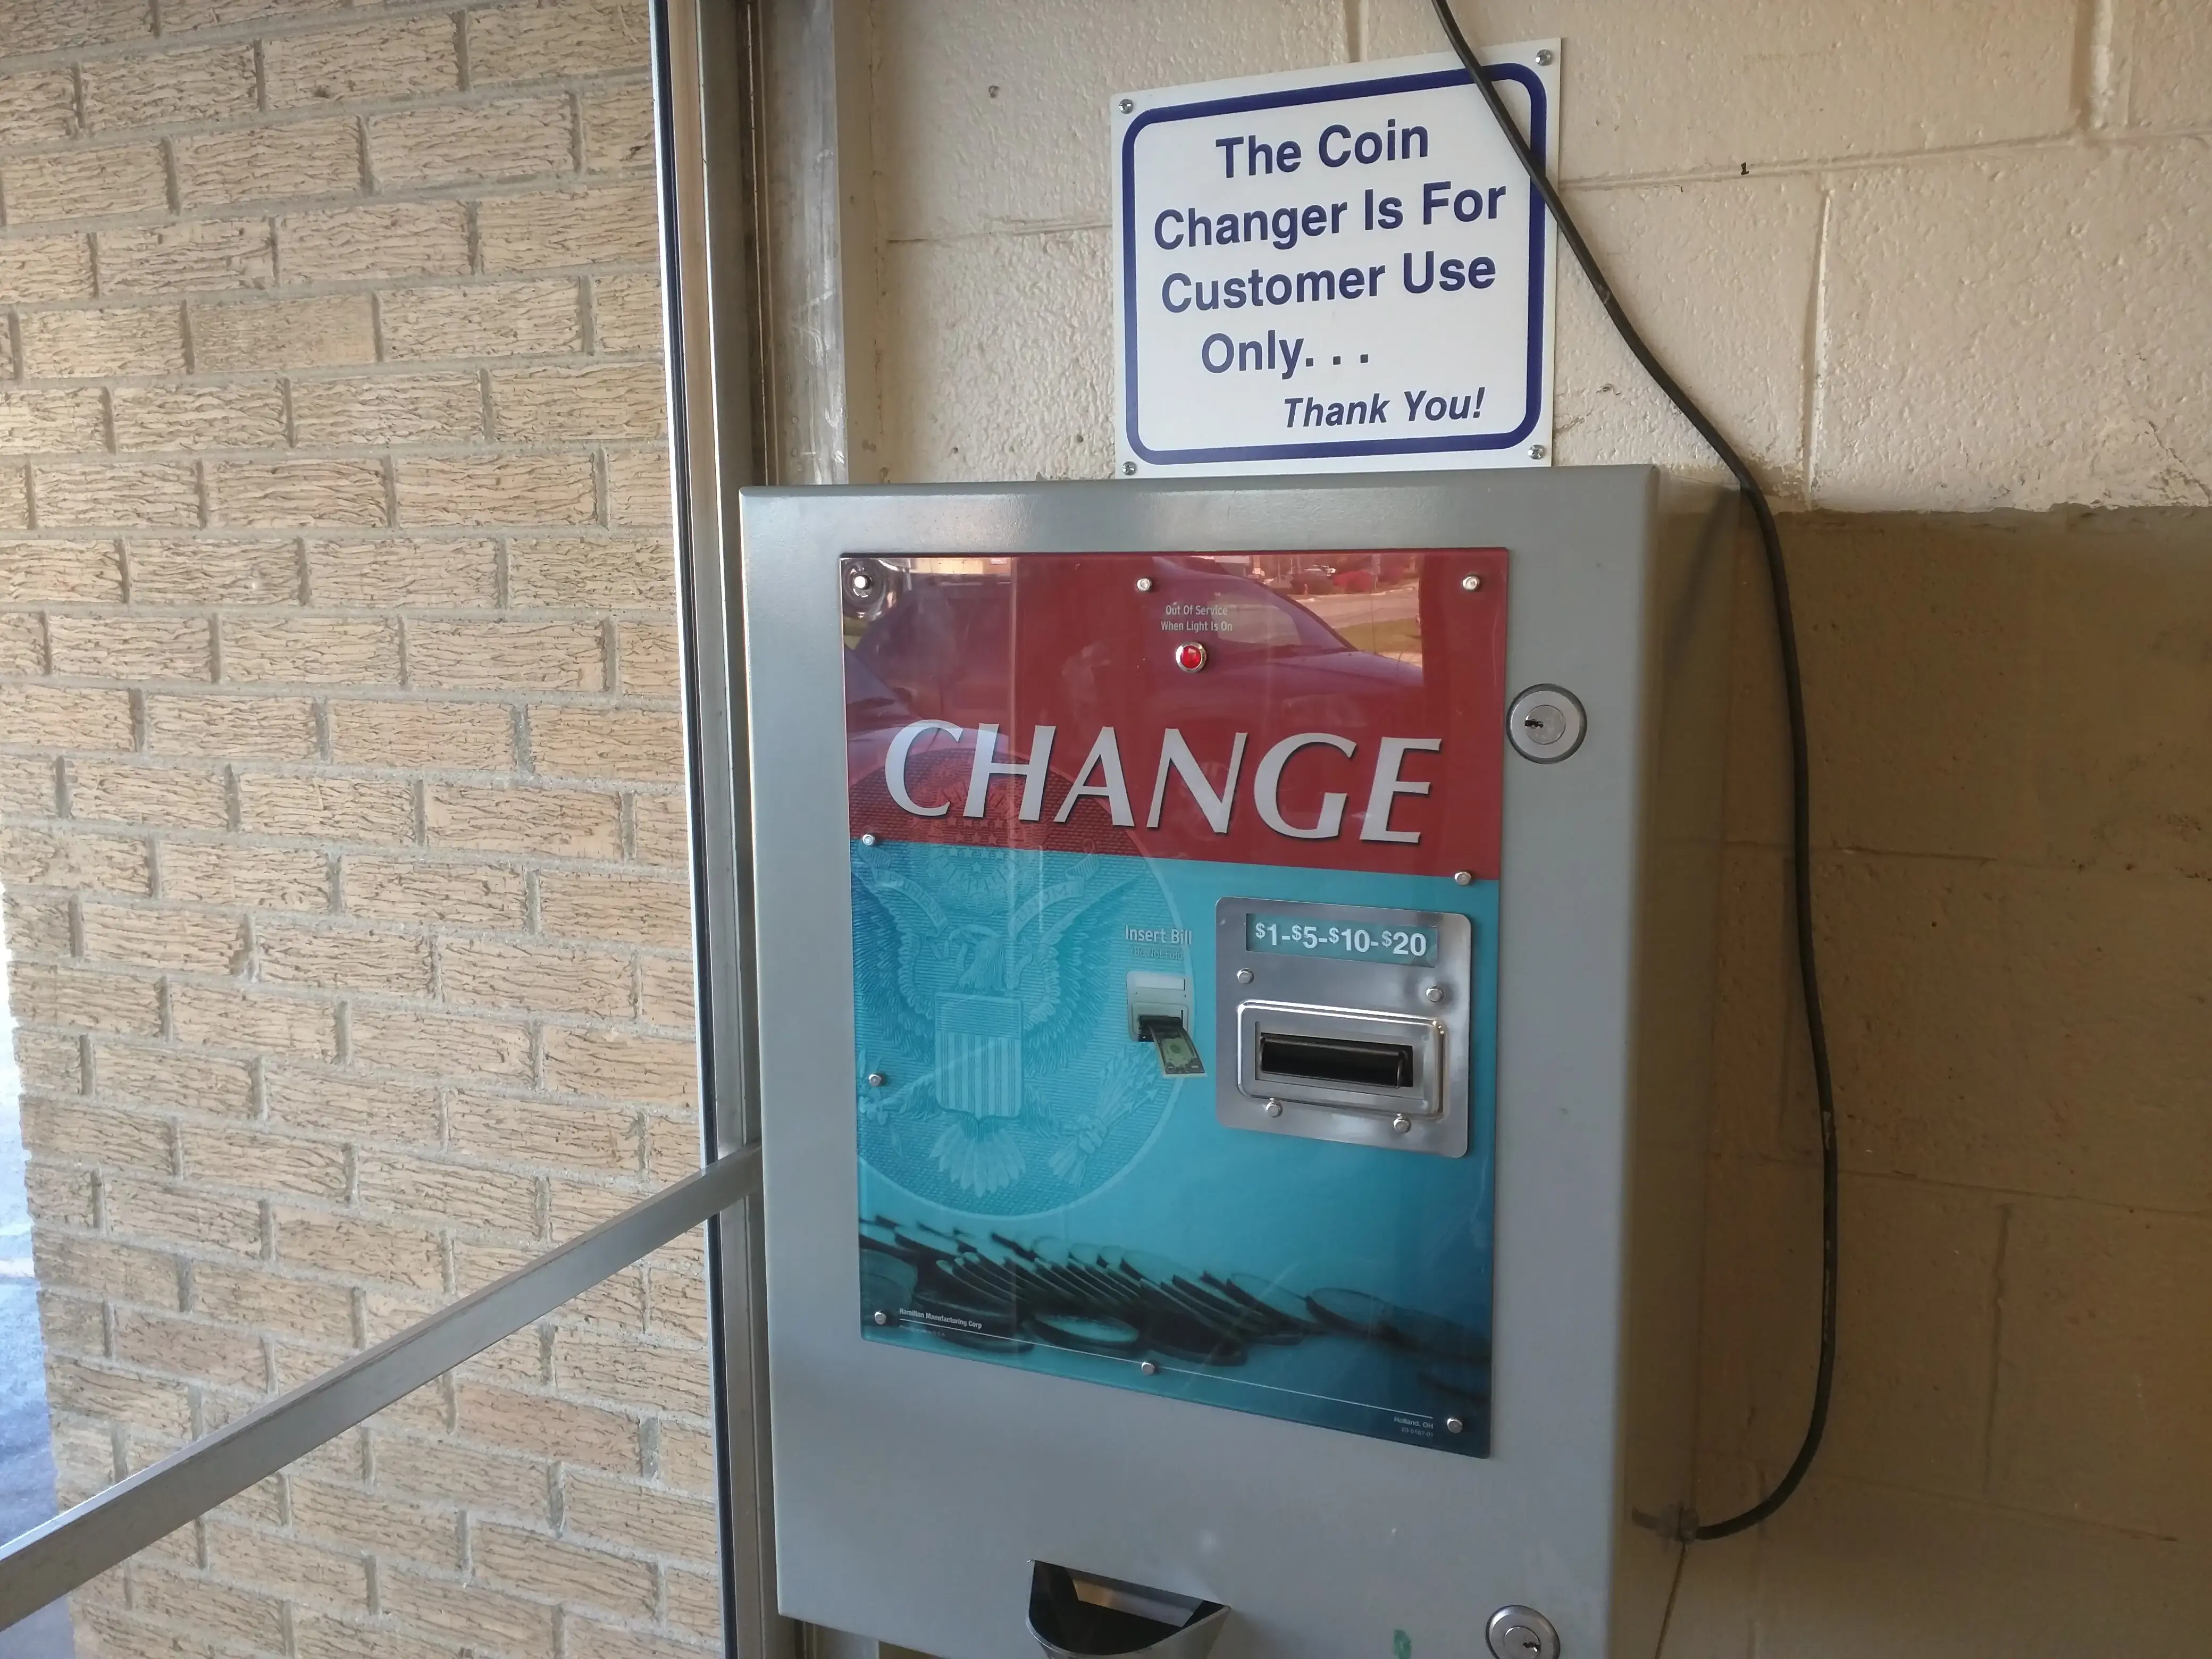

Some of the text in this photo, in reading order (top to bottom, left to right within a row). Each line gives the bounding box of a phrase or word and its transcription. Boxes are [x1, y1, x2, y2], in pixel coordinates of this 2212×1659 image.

[1215, 118, 1429, 179] The Coin
[1154, 181, 1506, 249] Changer Is For
[1161, 250, 1496, 313] Customer Use
[1284, 387, 1486, 428] Thank You!
[1161, 621, 1233, 633] When Light Is On
[1165, 605, 1228, 616] Out Of Service
[884, 719, 1443, 844] CHANGE
[1125, 925, 1192, 945] Insert Bill
[899, 1308, 983, 1330] Hamilton Manufacturing Corp
